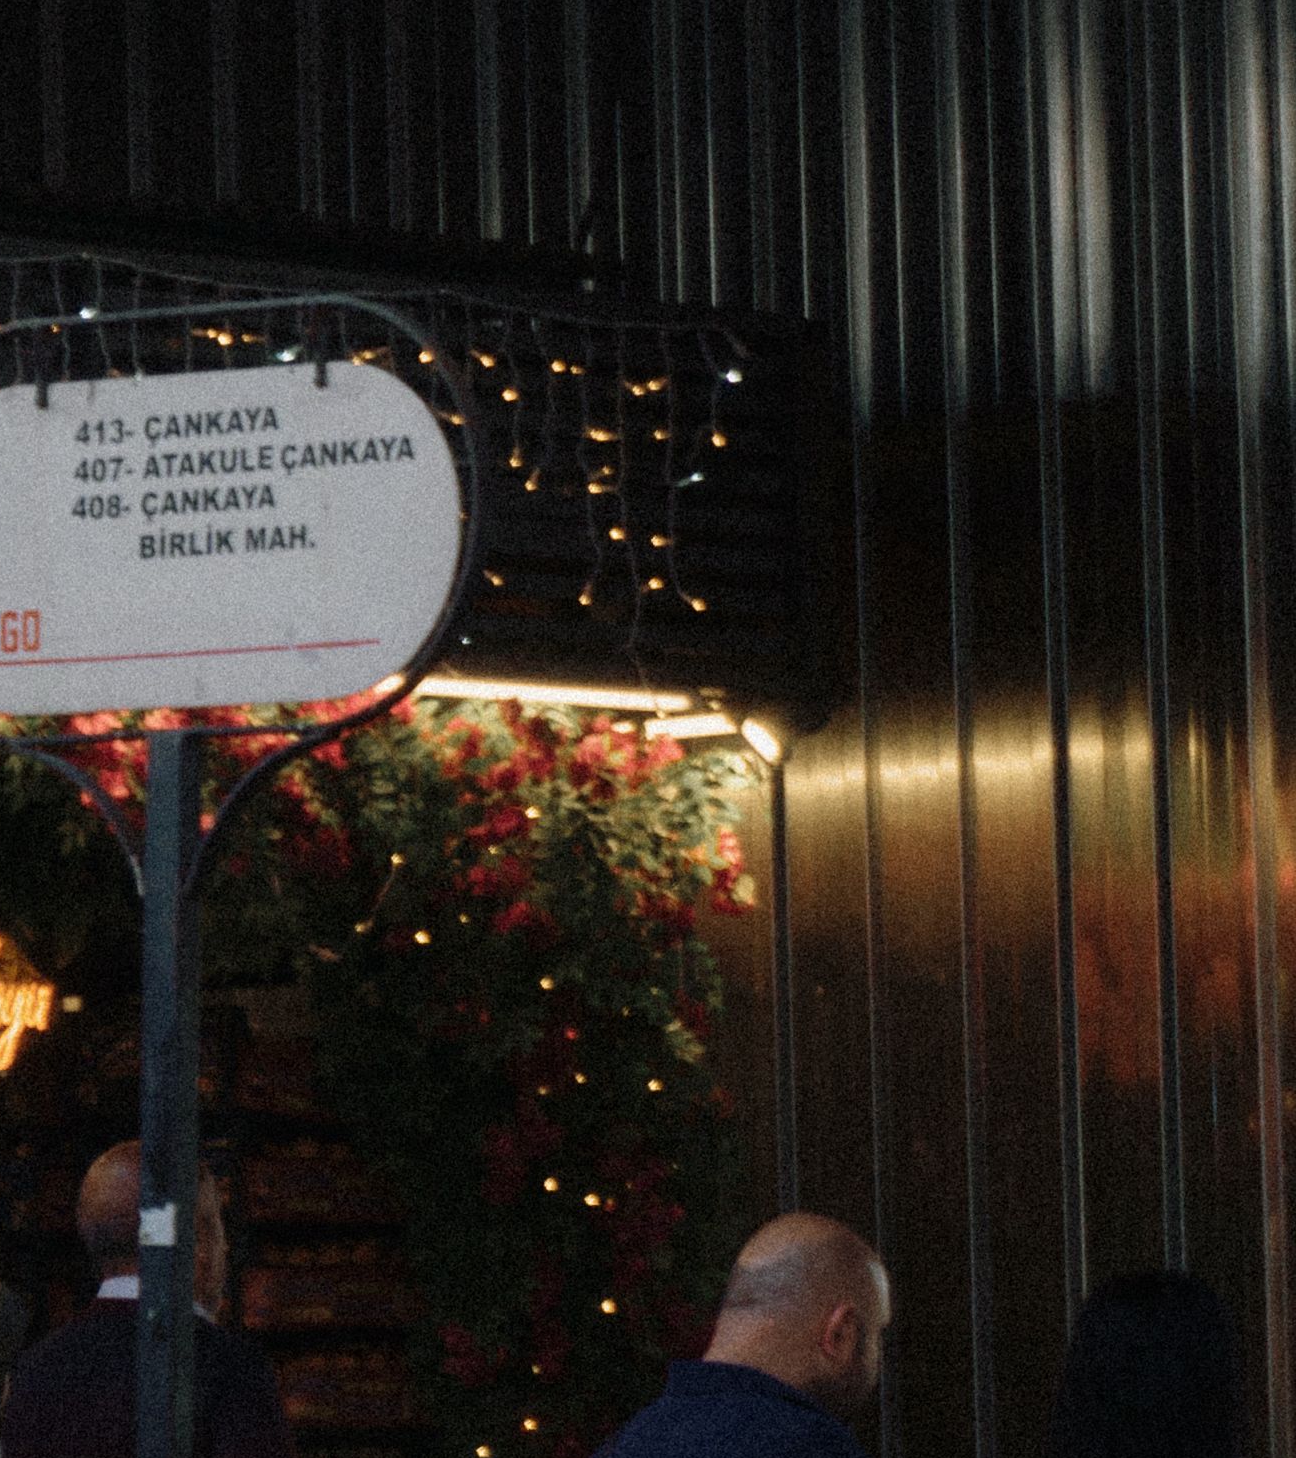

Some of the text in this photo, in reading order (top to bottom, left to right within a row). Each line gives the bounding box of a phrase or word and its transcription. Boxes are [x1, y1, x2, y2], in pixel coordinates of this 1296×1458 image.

[75, 405, 279, 446] 413- ÇANKAYA
[74, 435, 416, 484] 407- ATAKULE ÇANKAYA
[71, 484, 277, 521] 408- ÇANKAYA
[138, 525, 316, 560] BİRLİK MAH.
